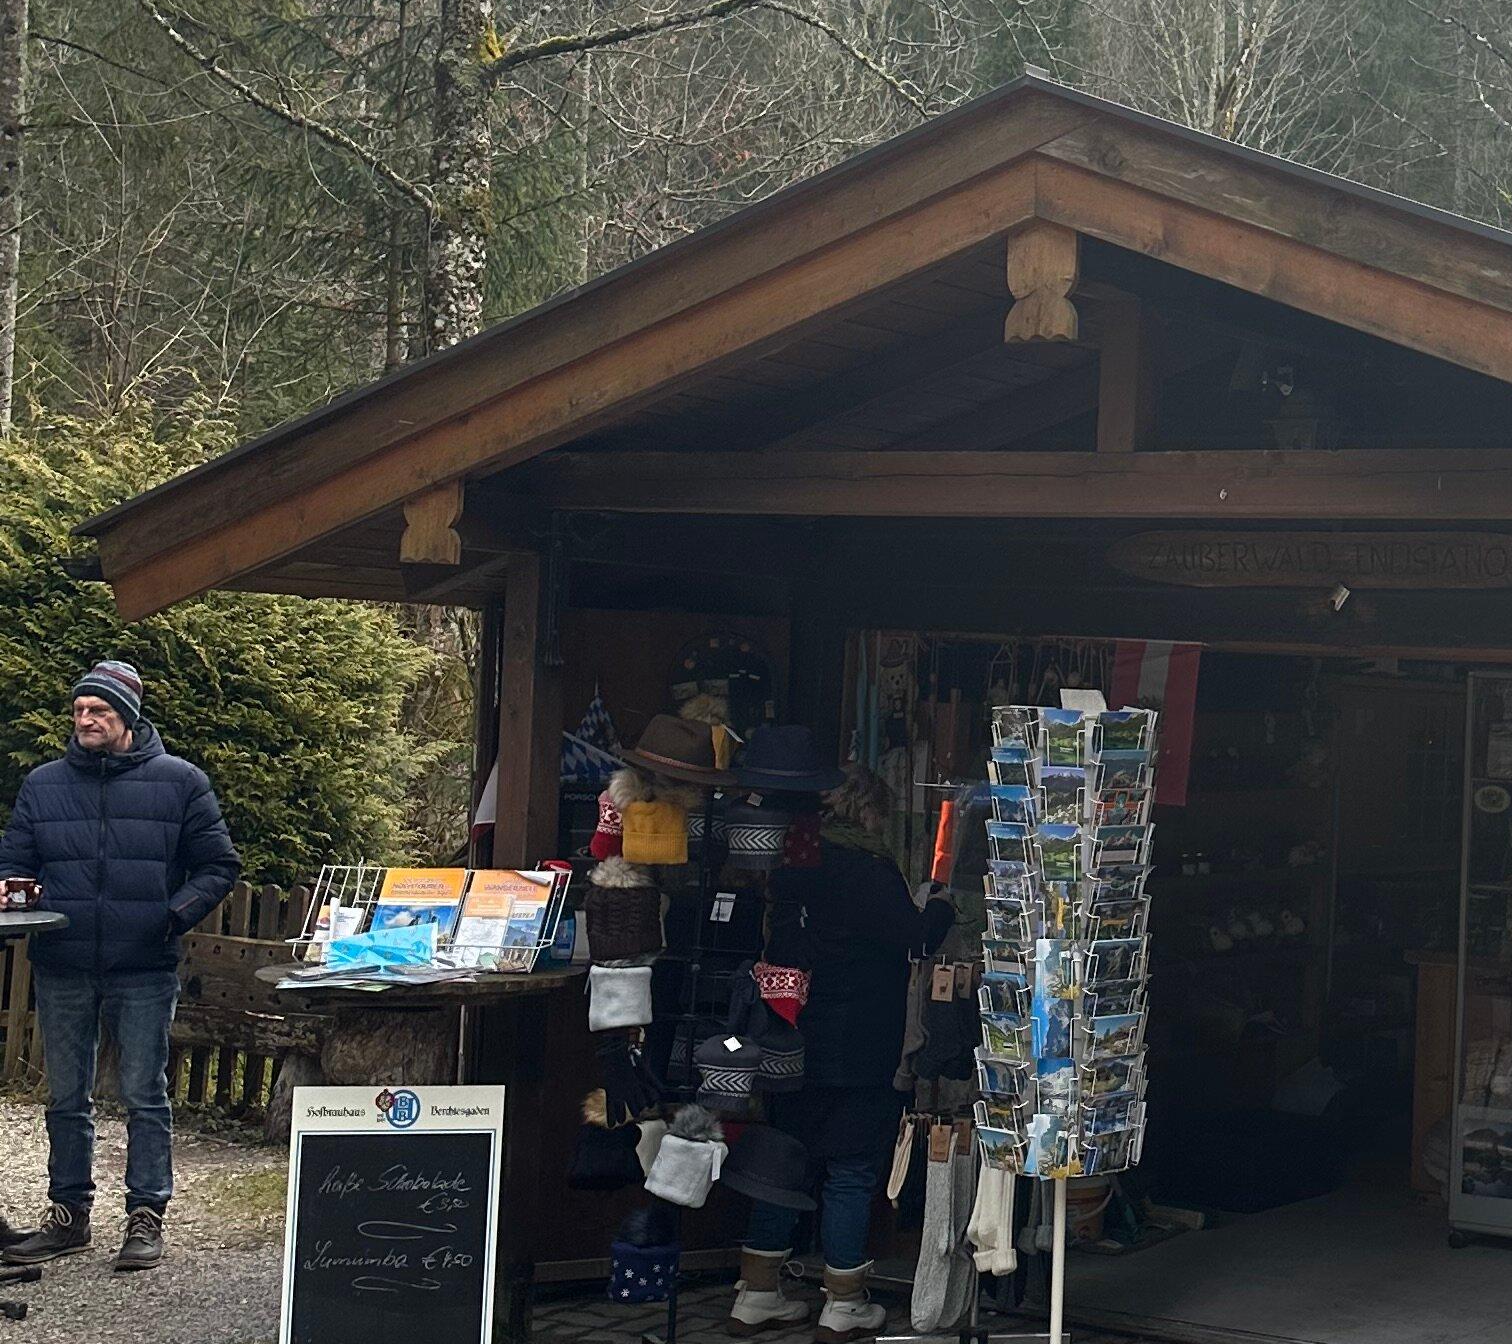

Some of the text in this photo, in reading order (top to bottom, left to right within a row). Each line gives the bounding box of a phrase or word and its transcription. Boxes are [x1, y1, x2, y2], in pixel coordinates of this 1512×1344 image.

[1149, 541, 1331, 573] ZAUBERWALD
[430, 1105, 490, 1118] Berchtesgaden
[367, 1163, 472, 1192] Schokolade
